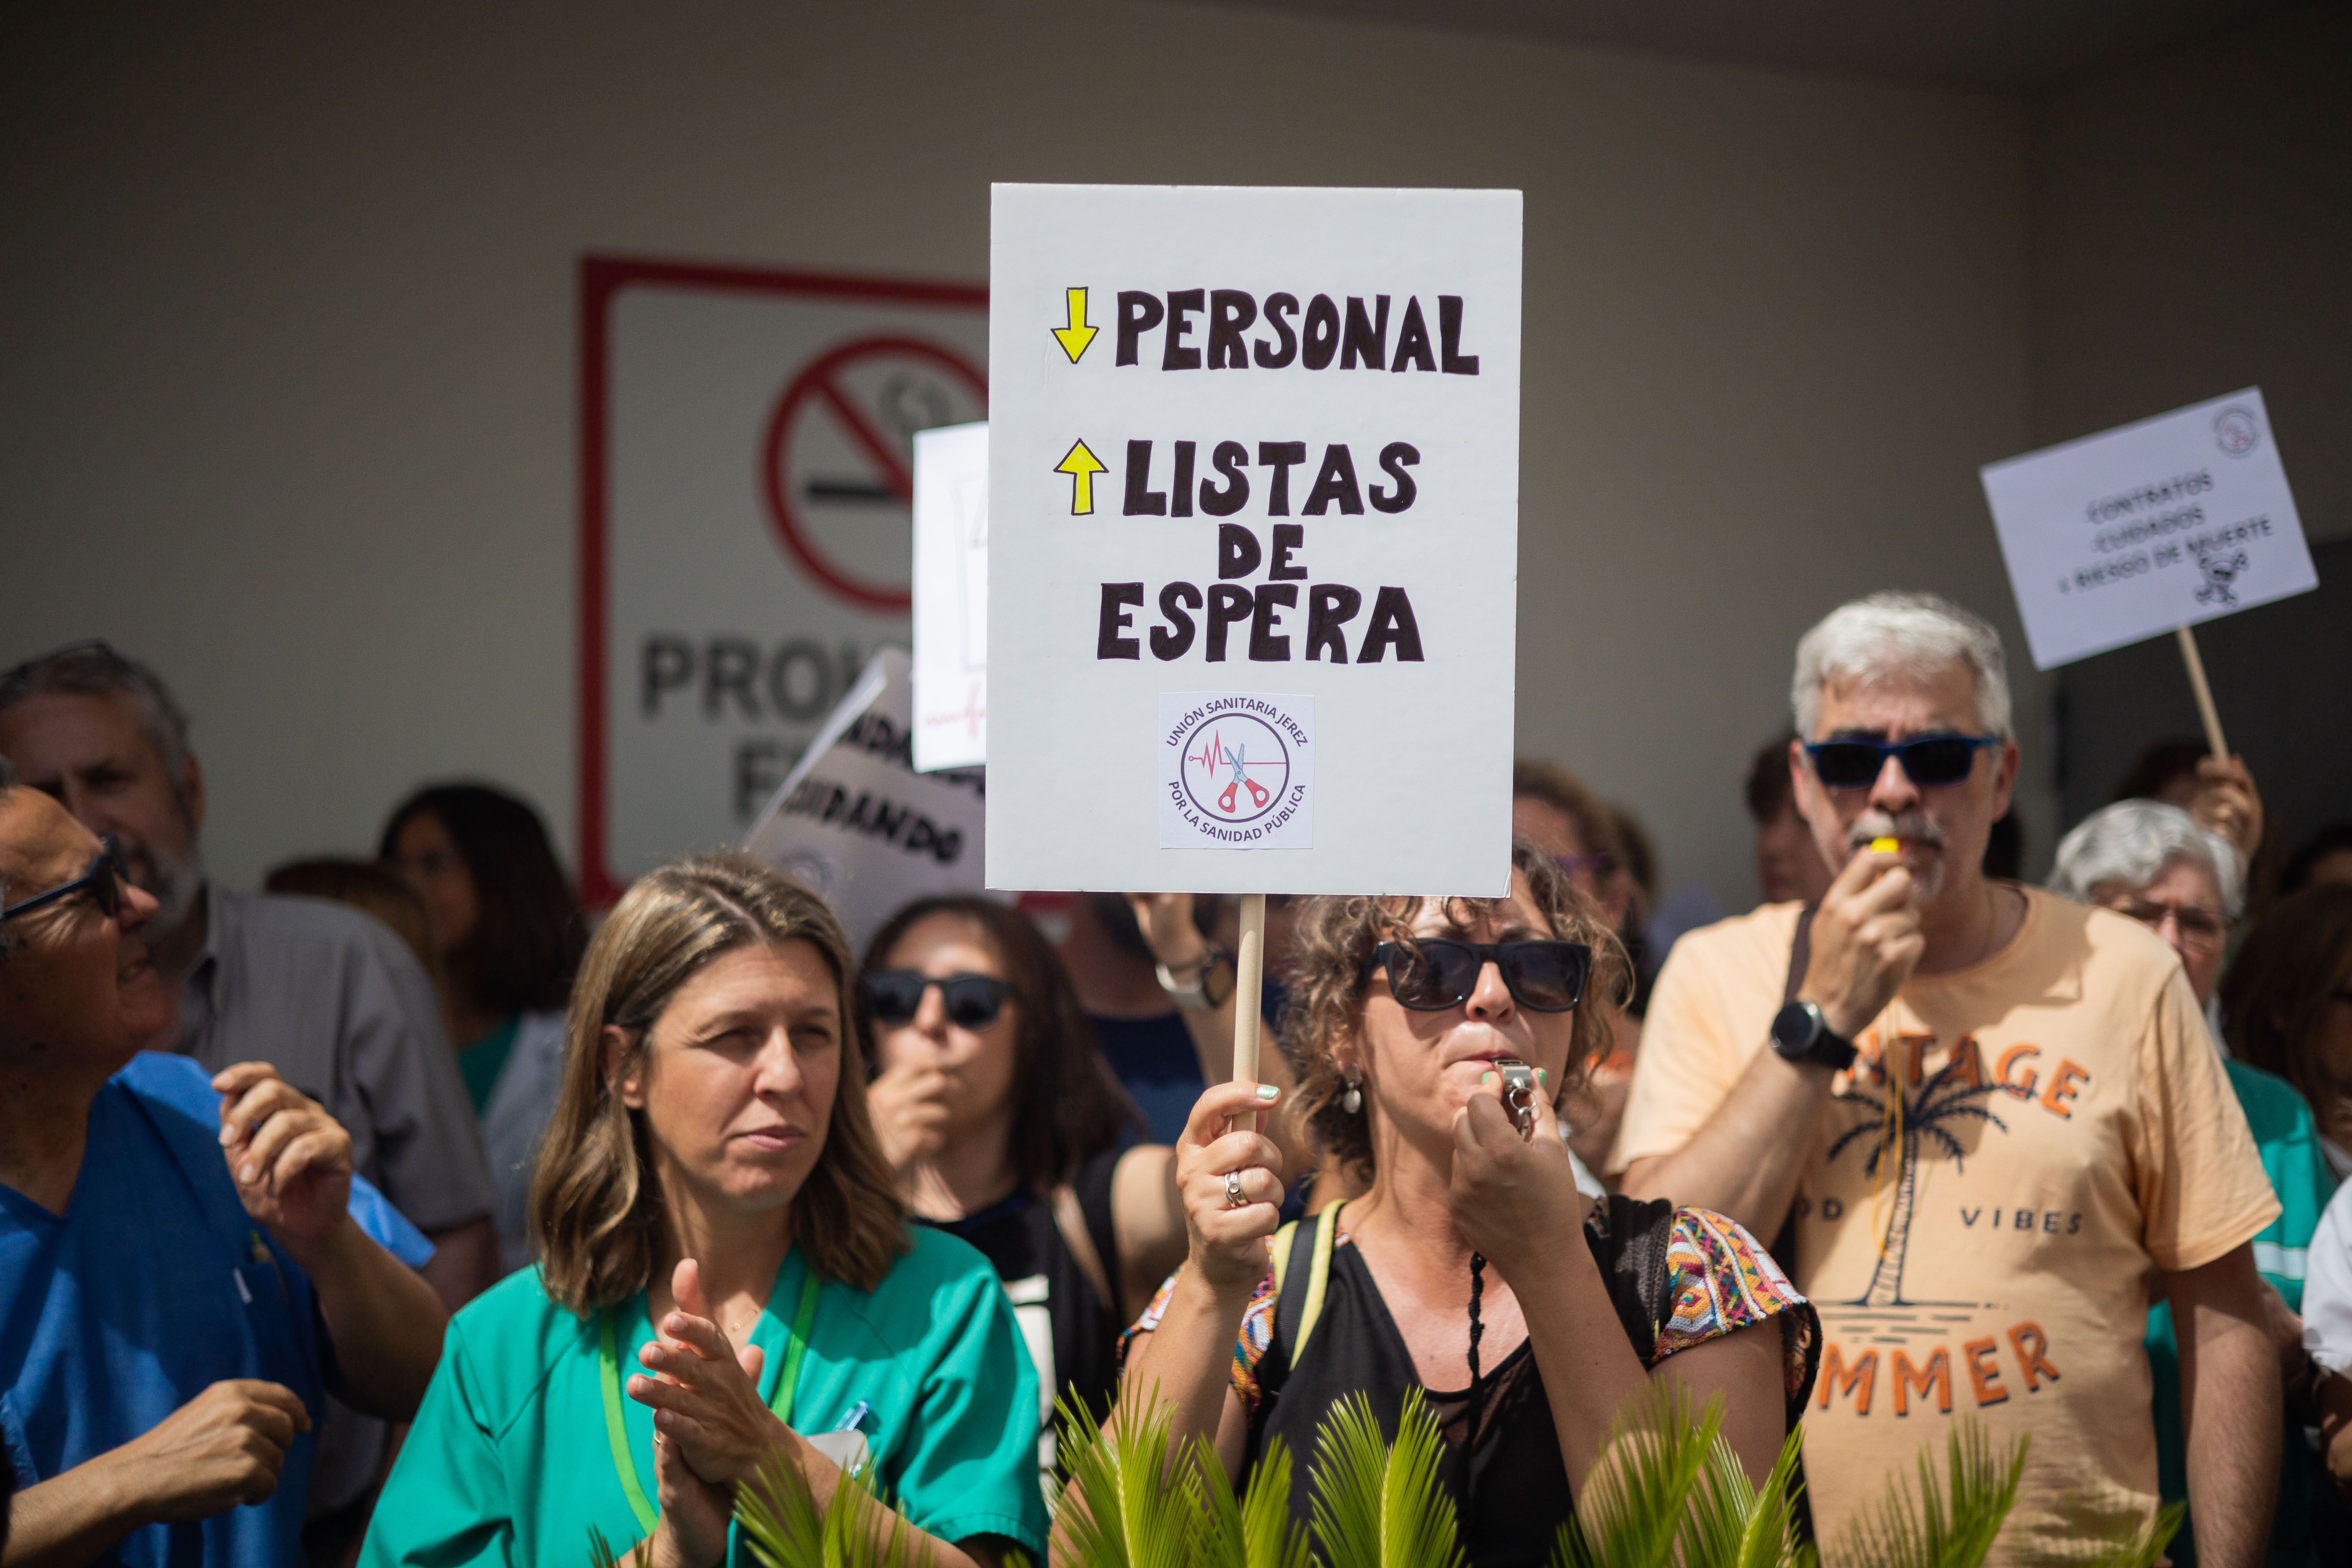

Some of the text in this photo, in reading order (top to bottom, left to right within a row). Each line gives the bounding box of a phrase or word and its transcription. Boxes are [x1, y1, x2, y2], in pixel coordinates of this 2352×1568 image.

[1116, 289, 1479, 375] PERSONAL
[1123, 439, 1420, 517] LISTAS
[1218, 523, 1308, 580] DE
[2153, 543, 2180, 567] DE
[2186, 514, 2273, 559] MUERTE
[1097, 582, 1424, 664] ESPERA
[1167, 698, 1308, 747] UNIÓN SANITARIA JEREZ
[1168, 781, 1306, 842] POR LA SANIDAD PÚBLICA
[1960, 1207, 2083, 1235] VIBES
